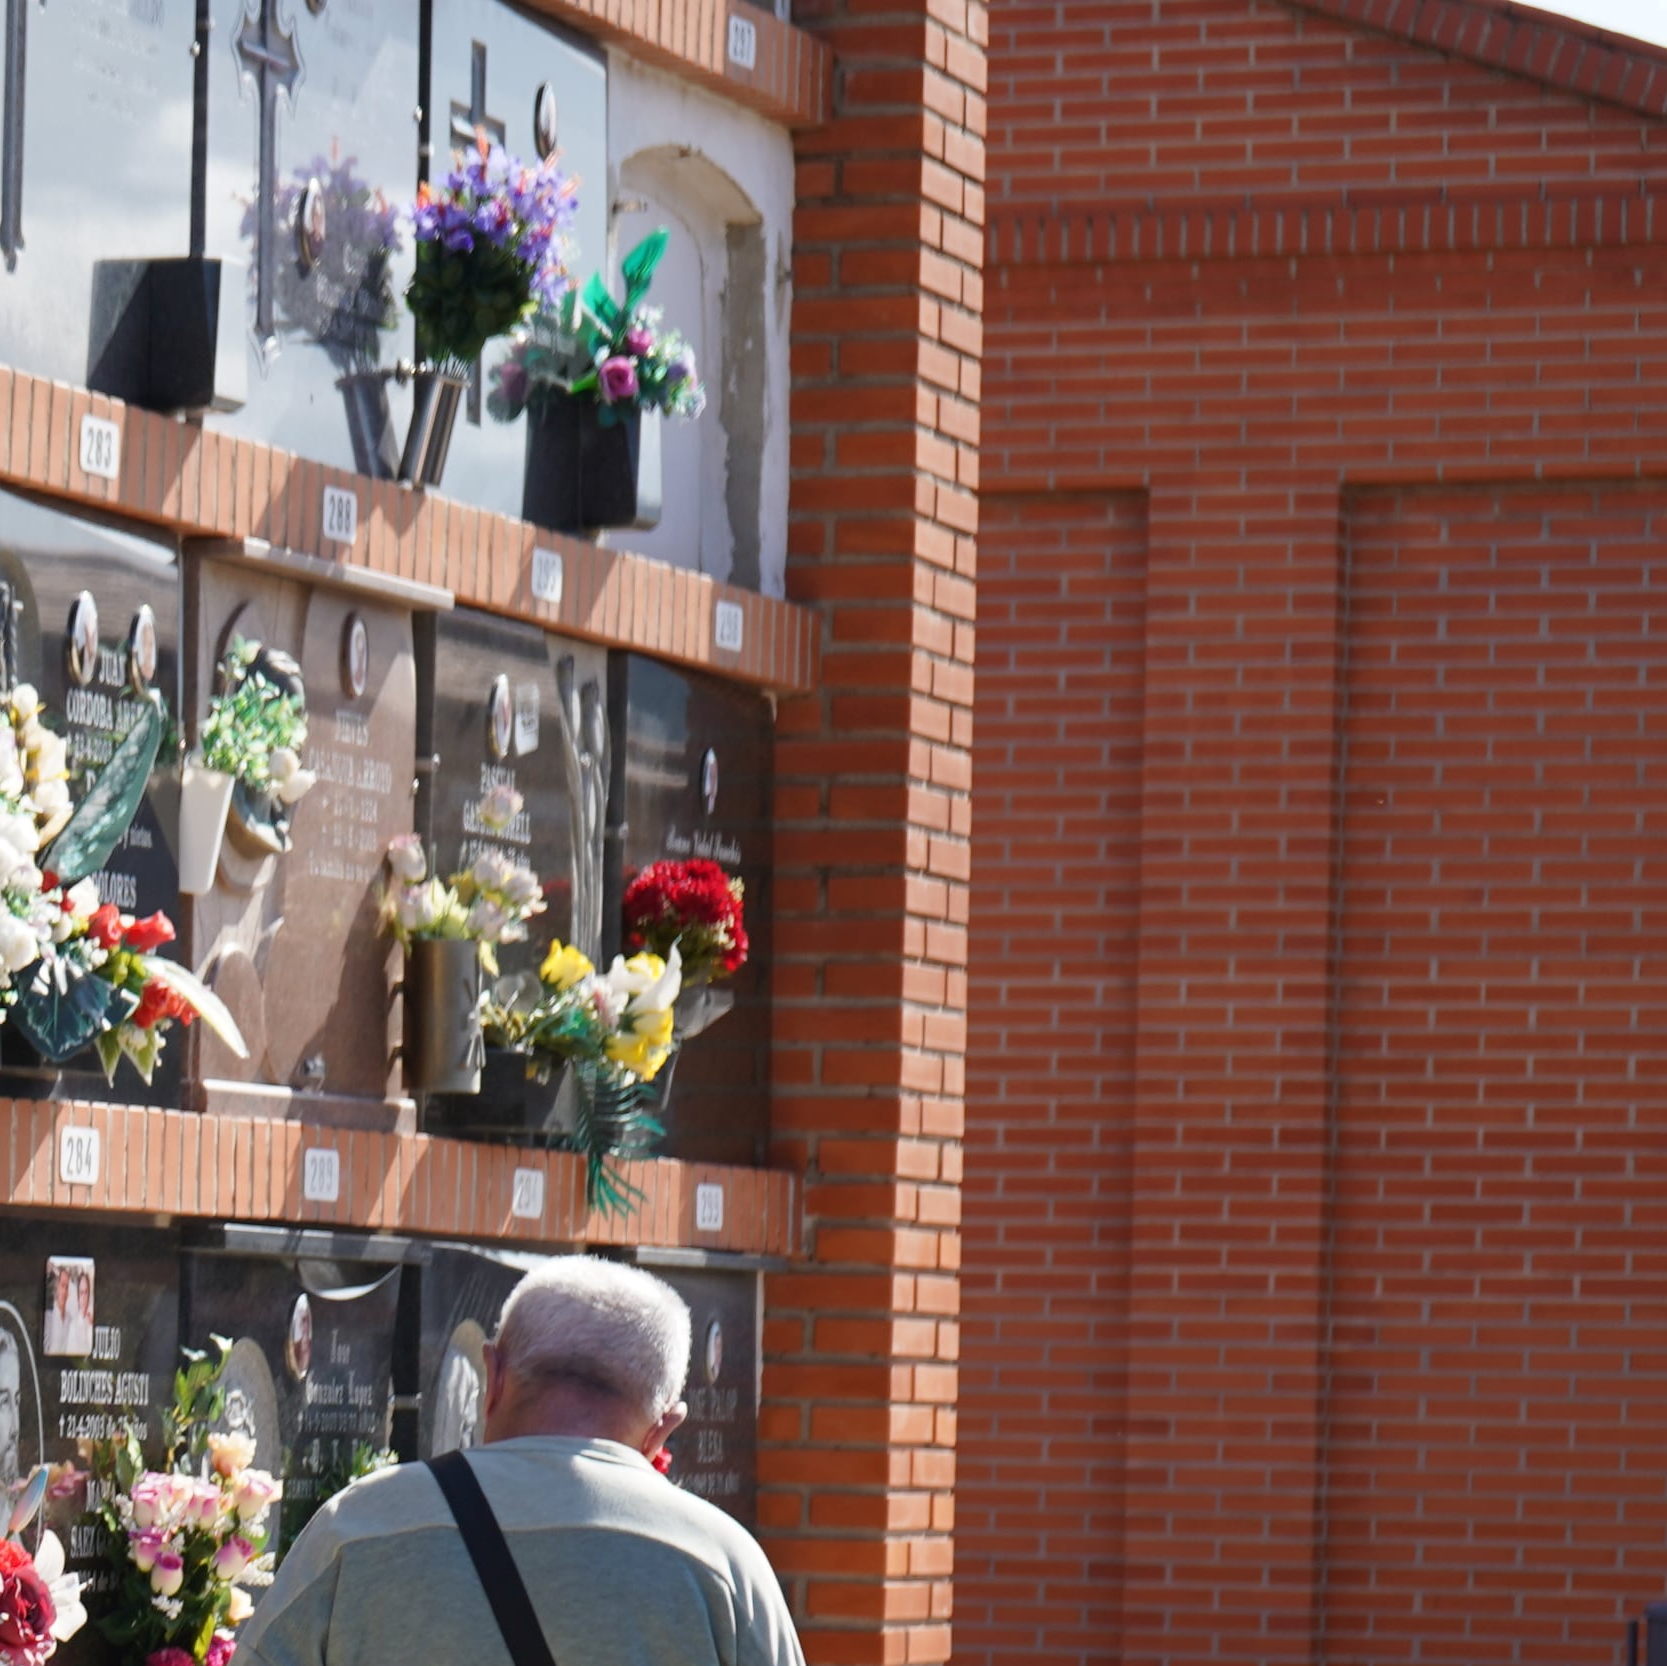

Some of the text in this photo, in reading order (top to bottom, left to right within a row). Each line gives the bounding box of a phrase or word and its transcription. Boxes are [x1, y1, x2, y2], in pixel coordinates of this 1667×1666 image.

[87, 427, 112, 469] 283
[67, 1136, 93, 1176] 284
[60, 1370, 113, 1404] BOLINCHES
